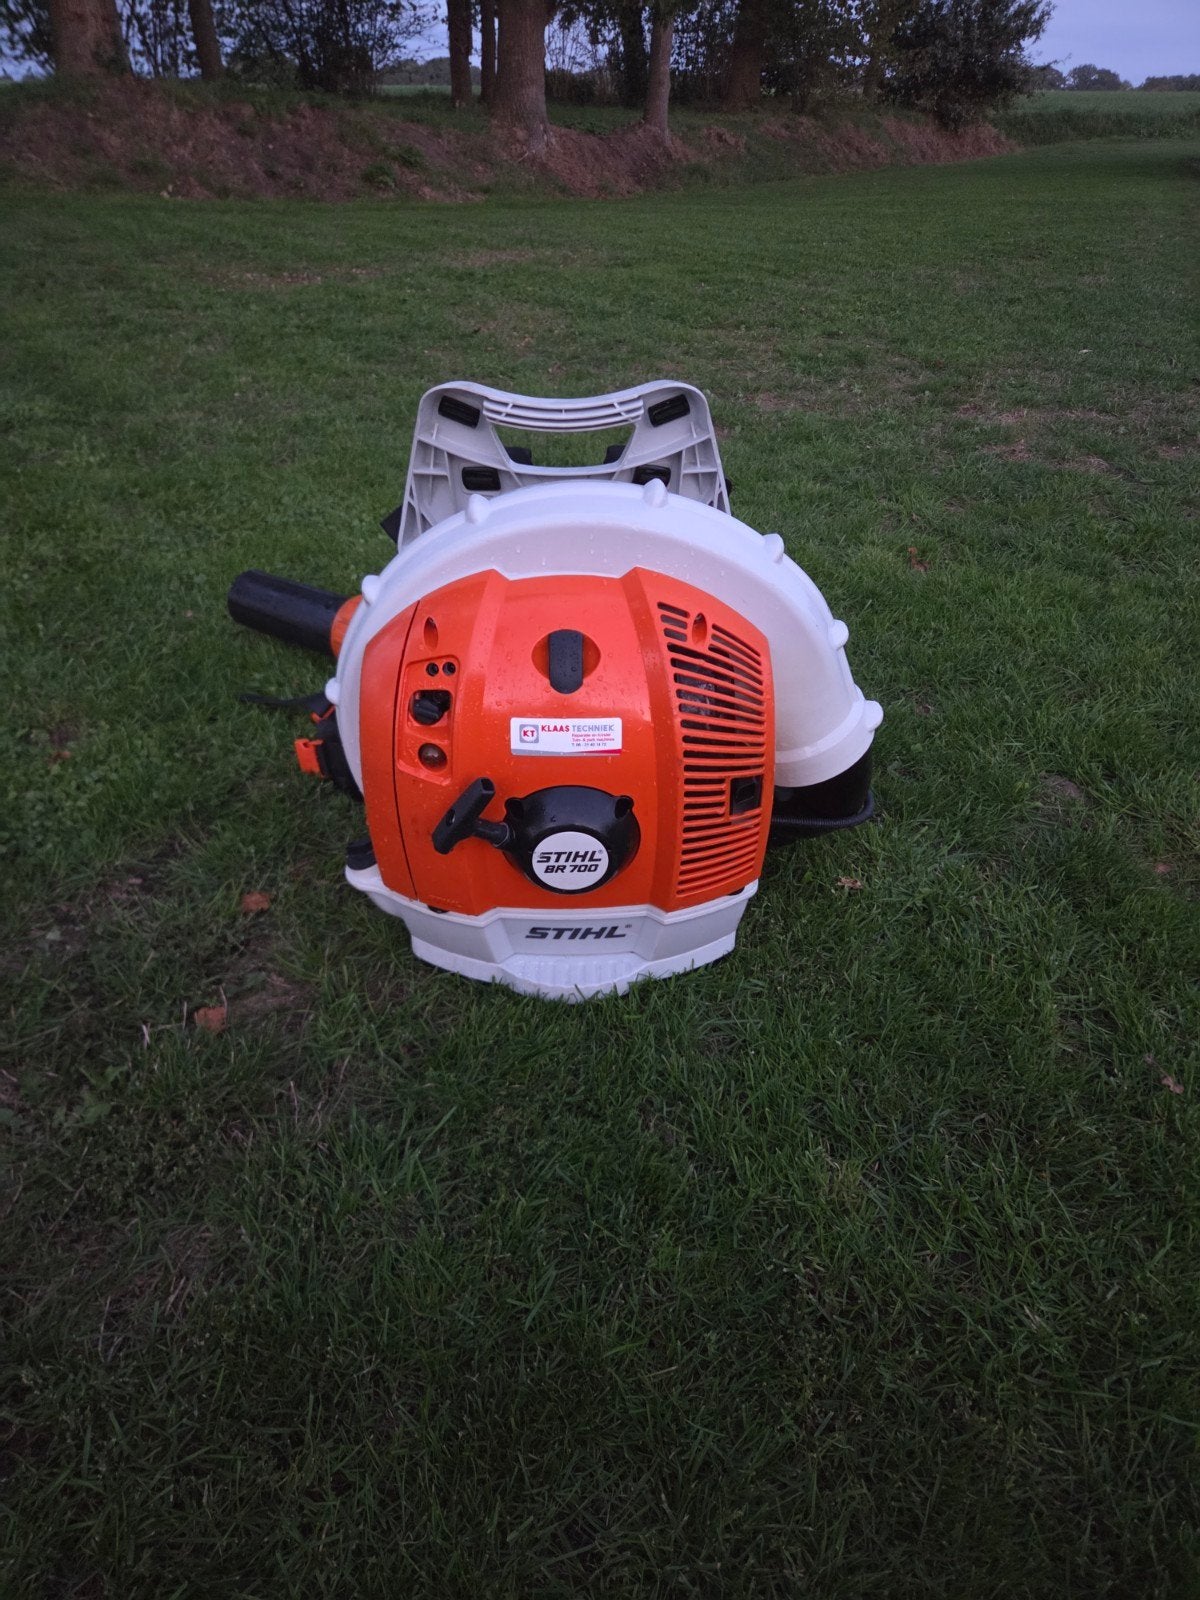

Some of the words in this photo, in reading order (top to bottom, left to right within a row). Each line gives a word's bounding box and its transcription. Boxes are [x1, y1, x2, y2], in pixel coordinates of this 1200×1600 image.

[572, 724, 615, 732] TECHNIEK
[537, 851, 602, 863] STIHL
[544, 864, 566, 873] BR
[570, 864, 599, 873] 700
[525, 926, 626, 940] STIHL
